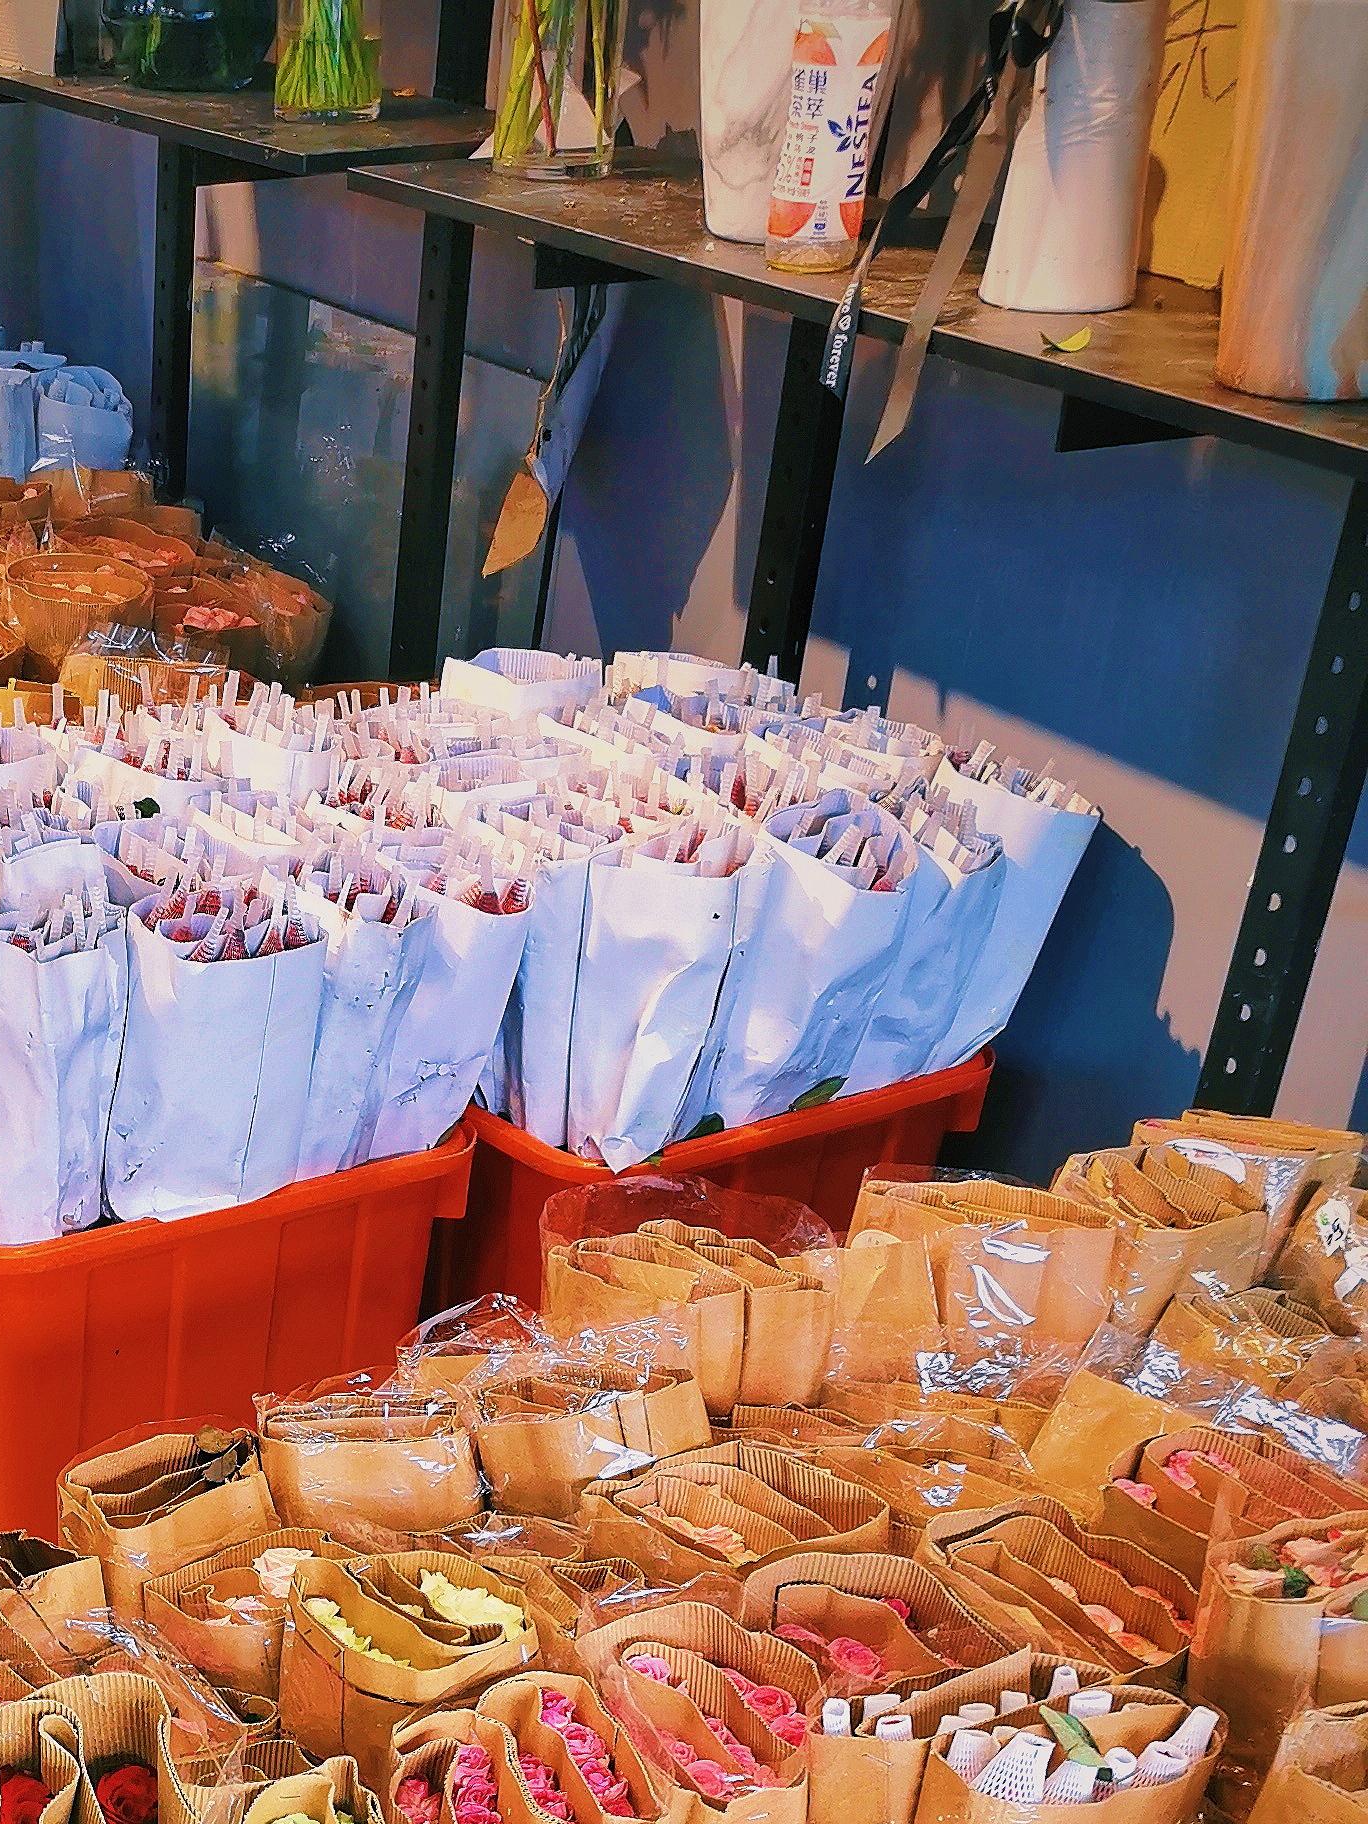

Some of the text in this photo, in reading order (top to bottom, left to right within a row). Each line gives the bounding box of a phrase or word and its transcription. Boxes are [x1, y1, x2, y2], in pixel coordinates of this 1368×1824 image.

[844, 72, 878, 199] NESTEA
[825, 282, 859, 388] love forever
